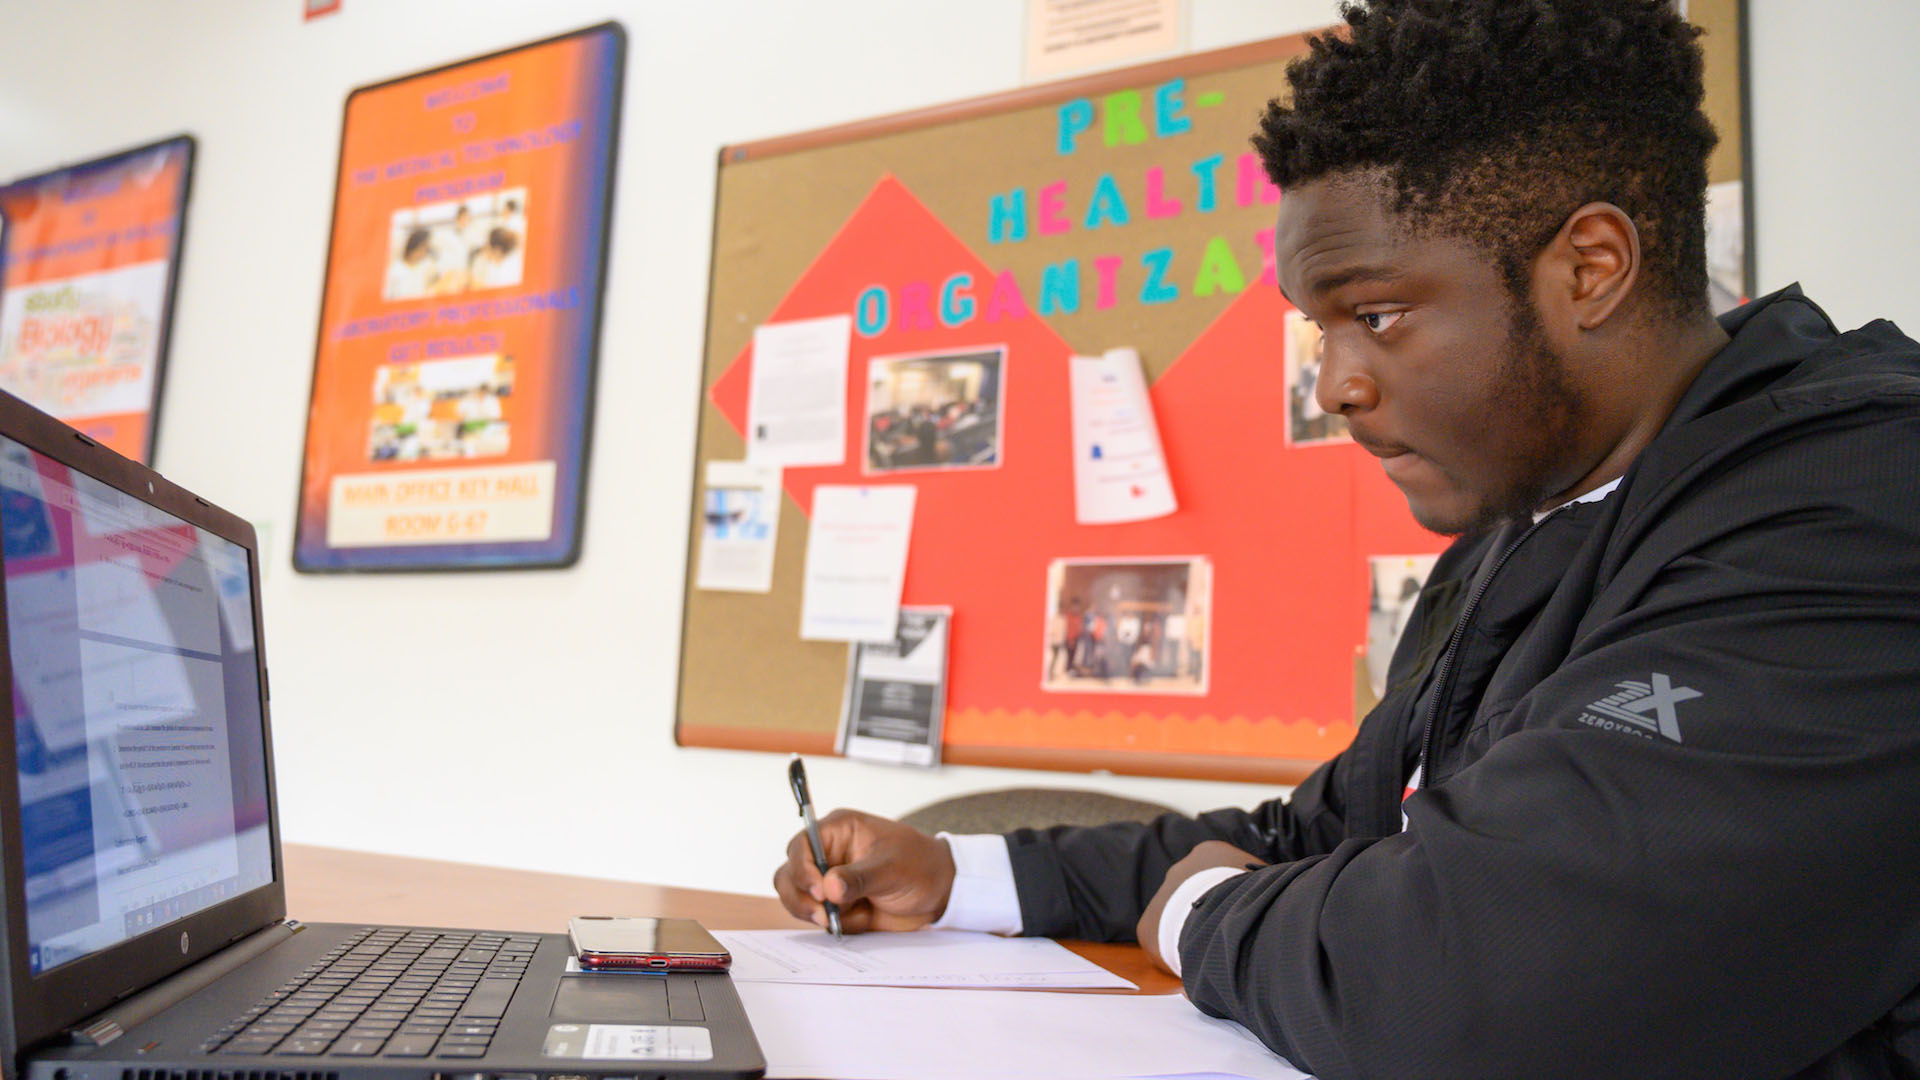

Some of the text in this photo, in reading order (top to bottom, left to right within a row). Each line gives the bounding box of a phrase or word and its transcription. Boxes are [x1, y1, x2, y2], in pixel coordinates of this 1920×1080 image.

[1057, 78, 1225, 155] PRE-
[988, 153, 1281, 243] HEALTH
[18, 313, 113, 355] Biology
[343, 482, 388, 505] MAIN
[396, 479, 451, 501] OFFICE
[496, 474, 539, 497] HALL
[386, 515, 443, 536] ROOM
